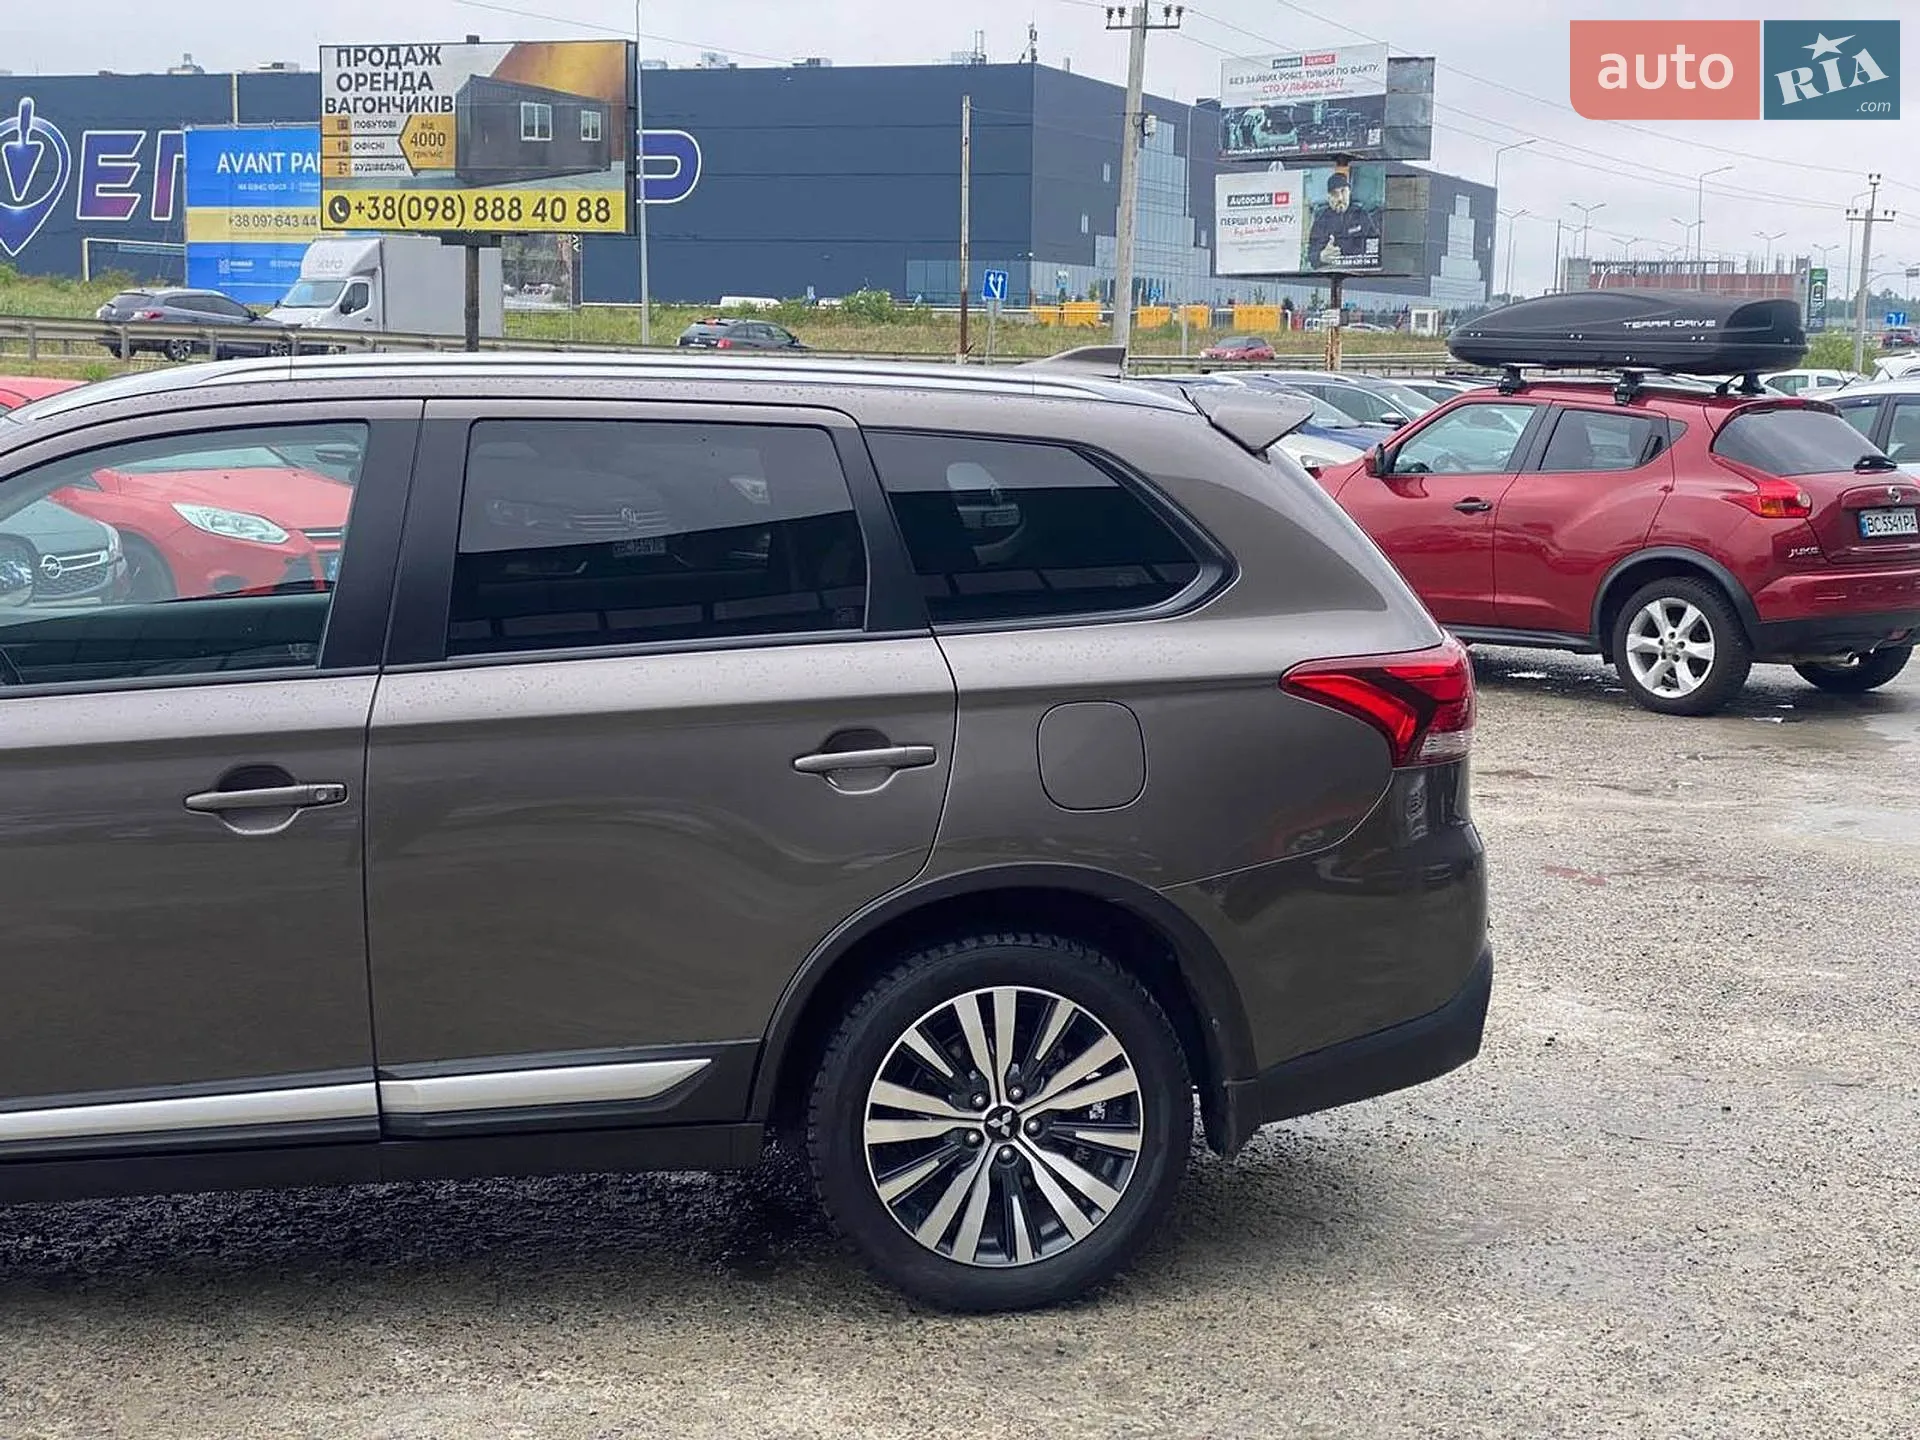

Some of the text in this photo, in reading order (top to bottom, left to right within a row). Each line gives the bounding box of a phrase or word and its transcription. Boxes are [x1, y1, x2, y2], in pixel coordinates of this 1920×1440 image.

[336, 46, 442, 70] ПРОДАЖ
[336, 70, 434, 95] ОРЕНДА
[325, 95, 454, 114] ВАГОНЧИКІВ
[410, 132, 447, 147] 4000
[215, 151, 286, 175] AVANT
[275, 214, 300, 227] 643
[302, 215, 317, 227] 44
[354, 193, 611, 228] +38(098) 888 40 88
[1623, 320, 1716, 329] TERRA DRIVE
